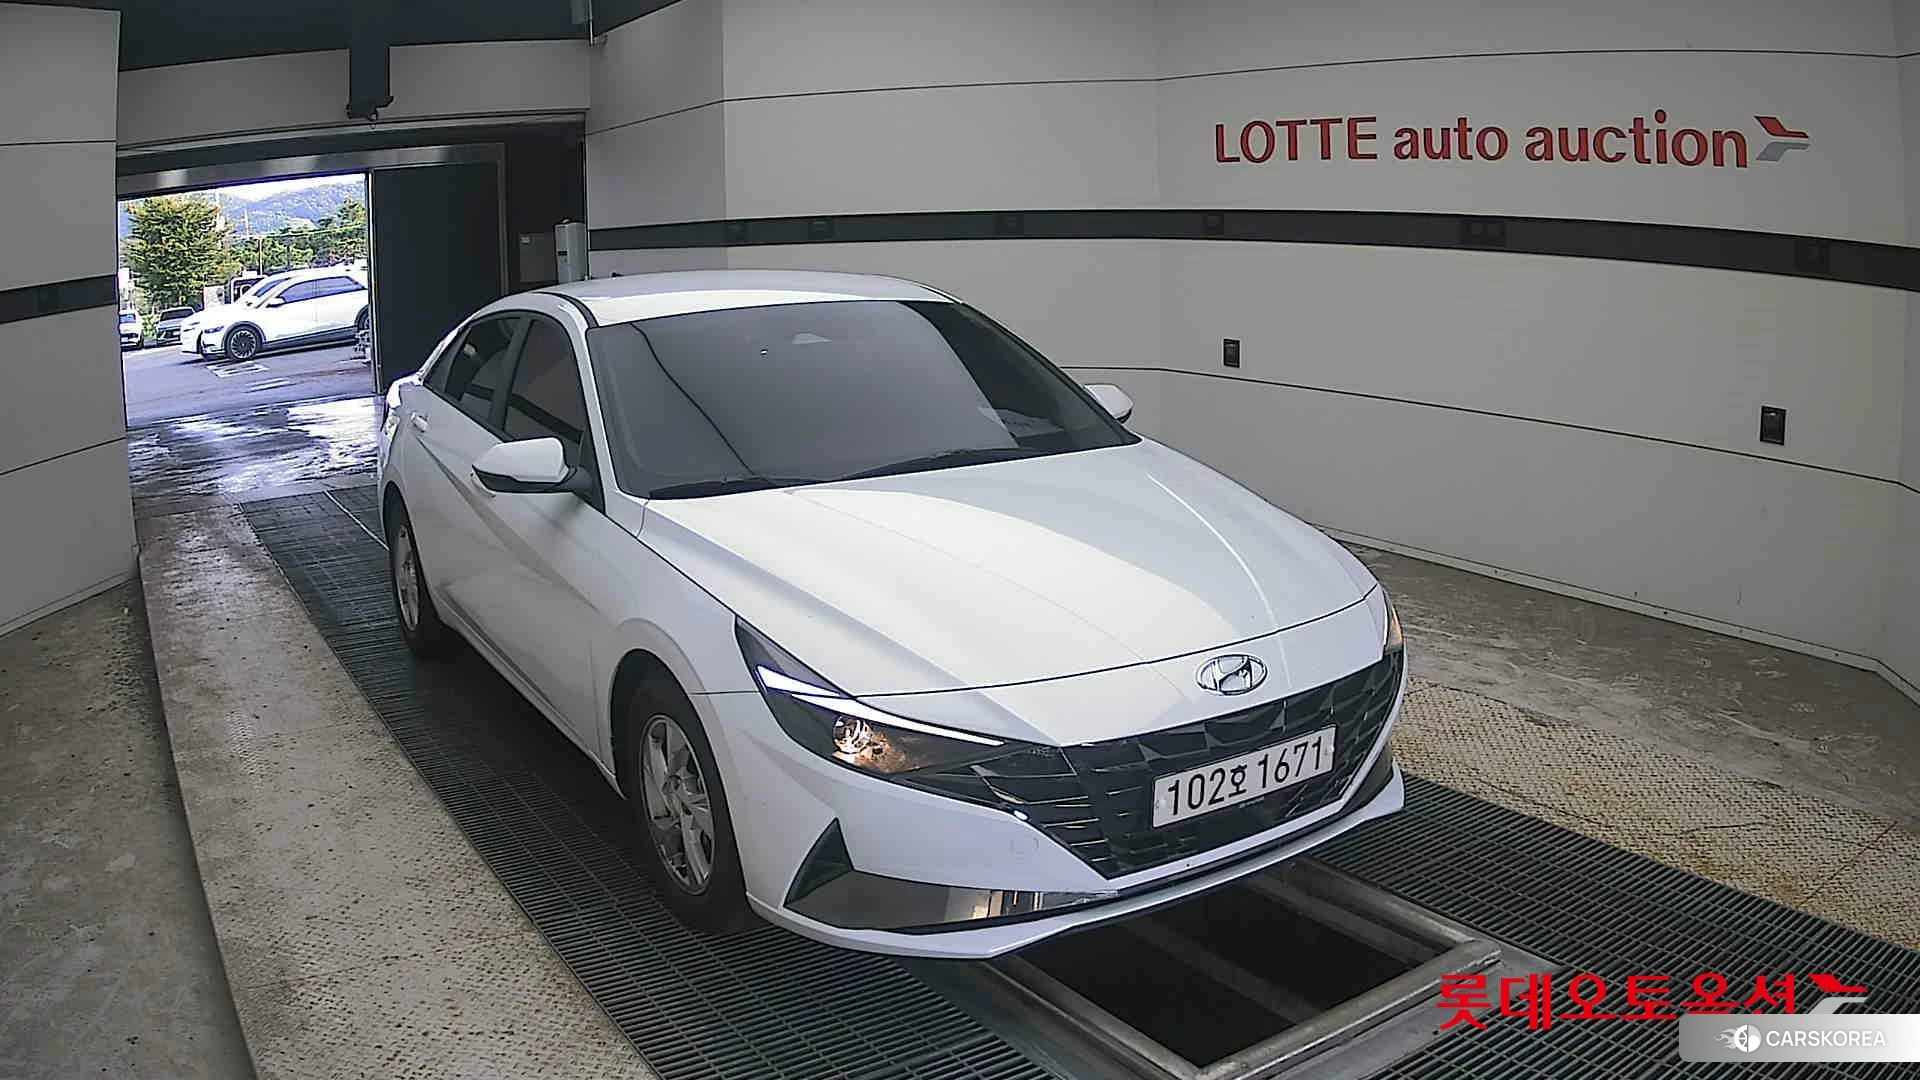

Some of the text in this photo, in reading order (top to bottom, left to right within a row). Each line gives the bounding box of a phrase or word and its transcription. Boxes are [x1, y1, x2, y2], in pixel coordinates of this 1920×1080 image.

[1214, 109, 1748, 168] LOTTE auto auction
[1168, 735, 1323, 815] 102호 1671
